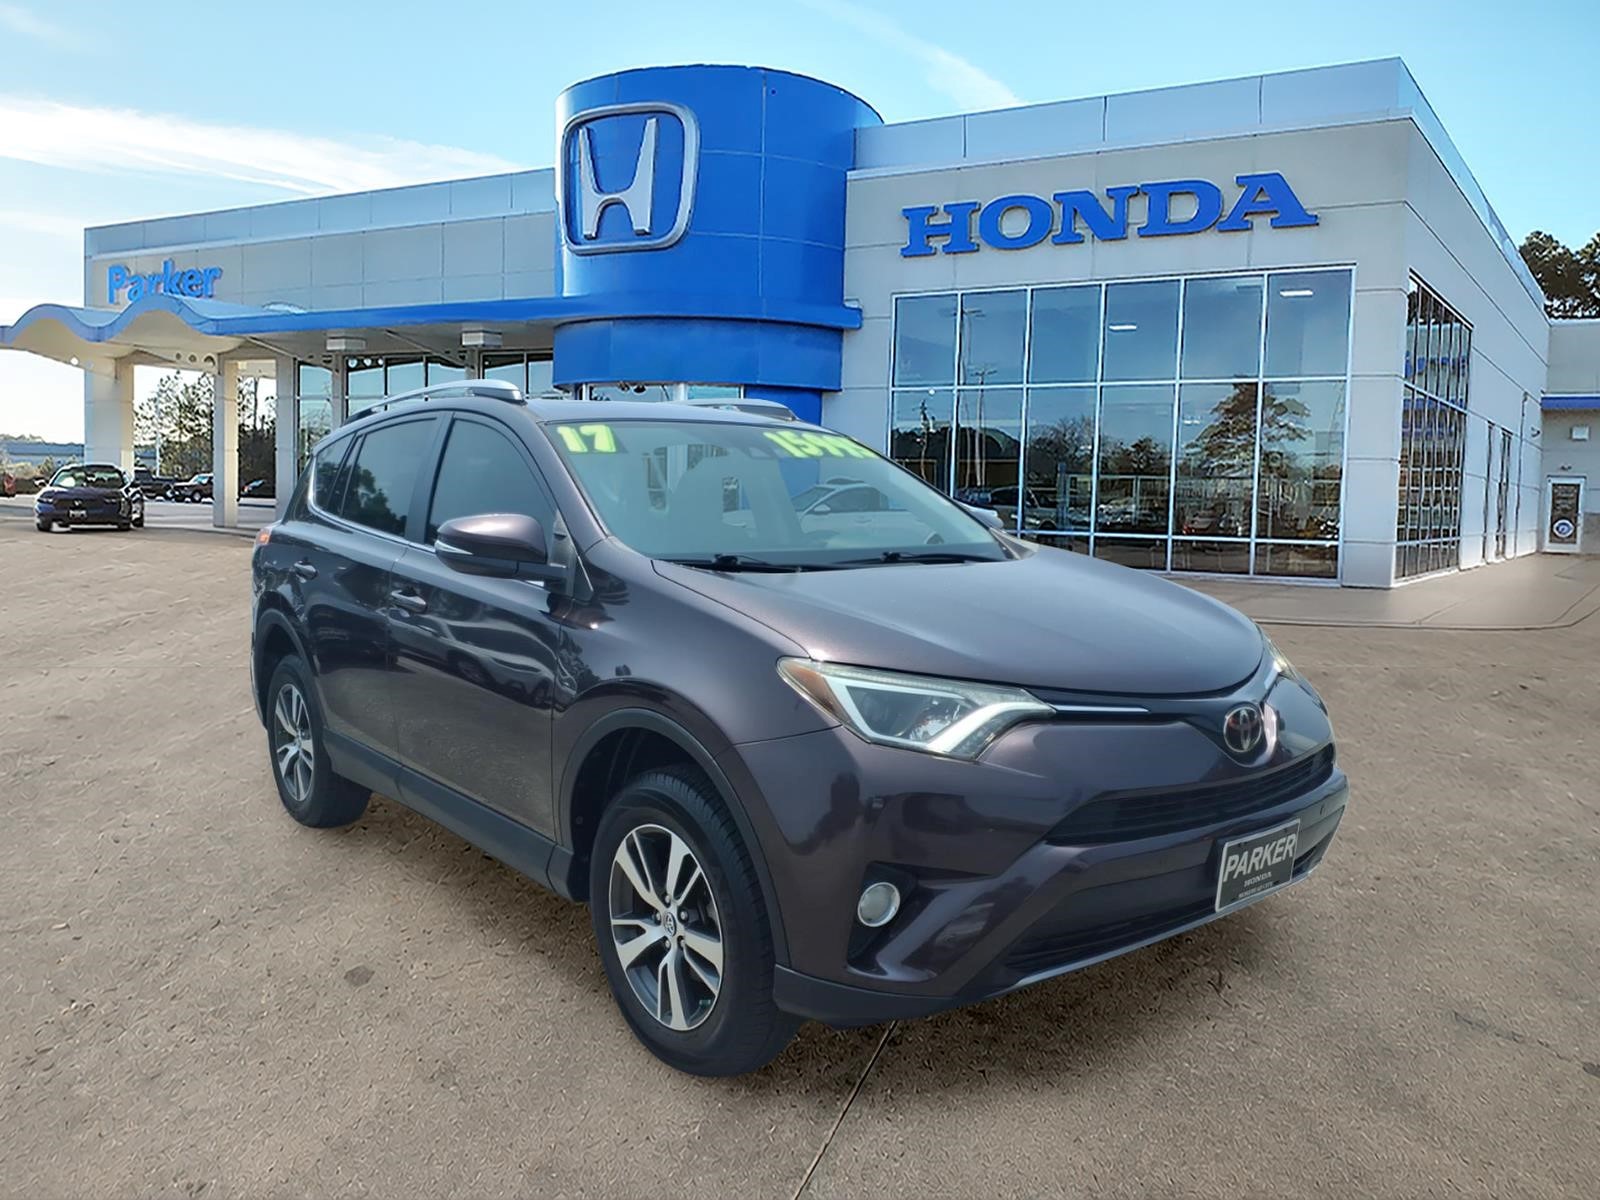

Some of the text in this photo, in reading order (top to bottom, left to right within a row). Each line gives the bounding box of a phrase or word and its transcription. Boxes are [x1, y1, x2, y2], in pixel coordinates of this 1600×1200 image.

[901, 171, 1319, 257] HONDA
[108, 259, 223, 304] Parker
[556, 424, 616, 453] 17
[1223, 833, 1297, 882] PARKER
[1244, 871, 1272, 887] HONDA
